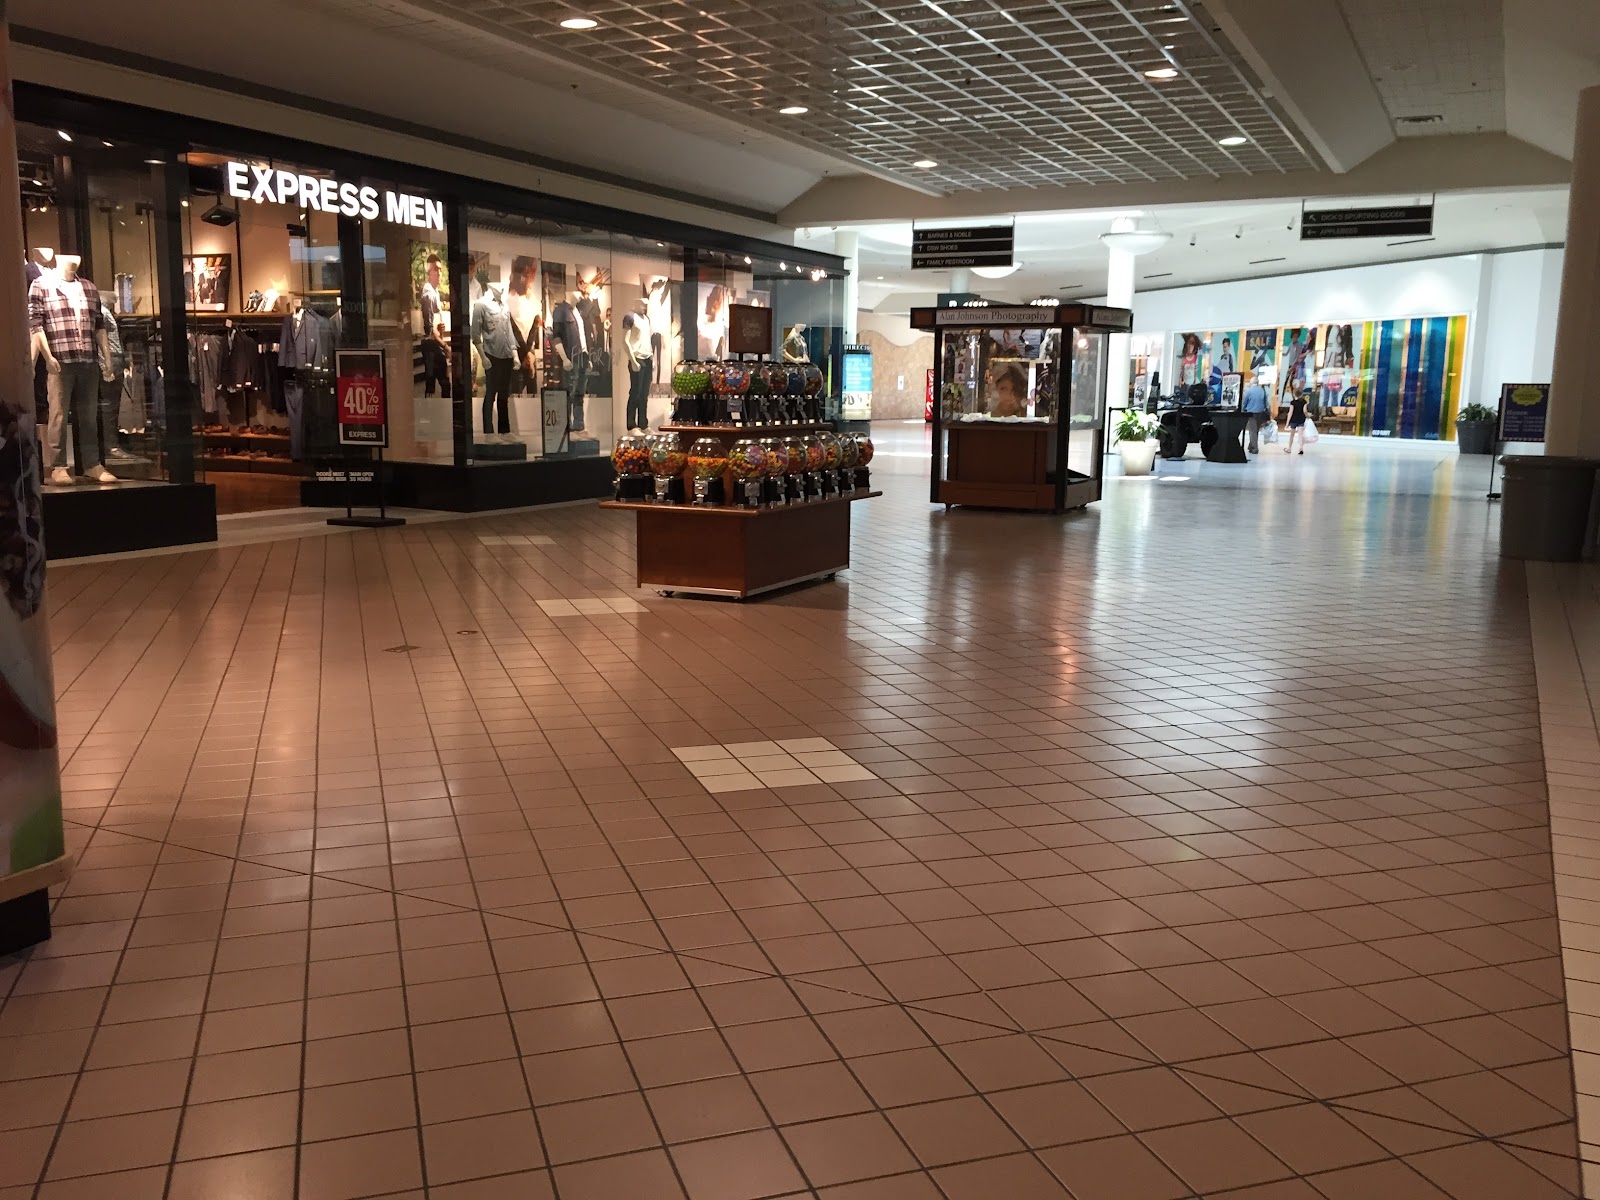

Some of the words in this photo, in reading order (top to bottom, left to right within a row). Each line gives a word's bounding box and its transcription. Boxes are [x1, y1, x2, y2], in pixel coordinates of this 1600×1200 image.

[227, 160, 380, 220] EXPRESS
[386, 190, 444, 231] MEN
[1344, 213, 1379, 221] SPORTING
[939, 309, 955, 321] Alan
[956, 308, 988, 321] Johnson
[991, 307, 1048, 322] Photography
[344, 387, 379, 414] 40%
[367, 404, 379, 414] OFF
[348, 431, 377, 439] EXPRESS
